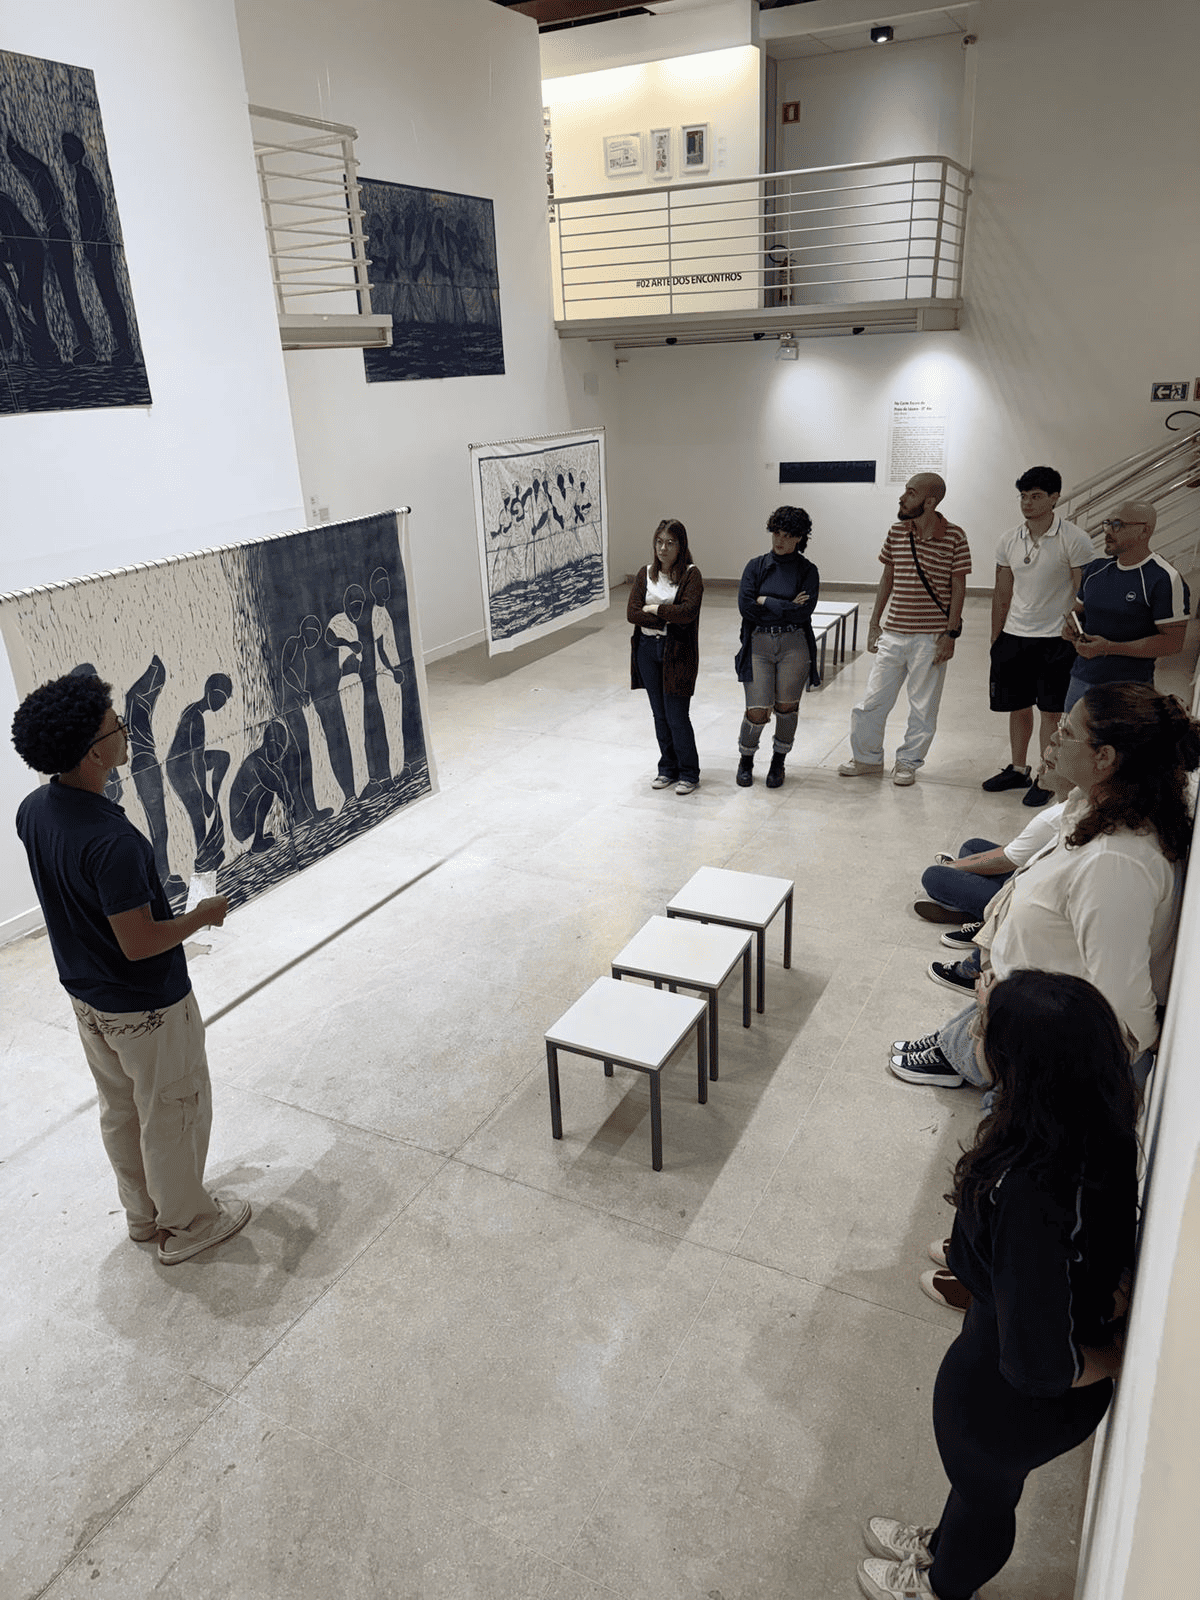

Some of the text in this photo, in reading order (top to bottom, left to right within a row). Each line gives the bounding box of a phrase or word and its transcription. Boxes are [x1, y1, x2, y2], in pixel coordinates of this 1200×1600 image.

[651, 278, 671, 287] ARTE
[672, 276, 690, 285] DOS
[691, 272, 742, 284] ENCONTROS
